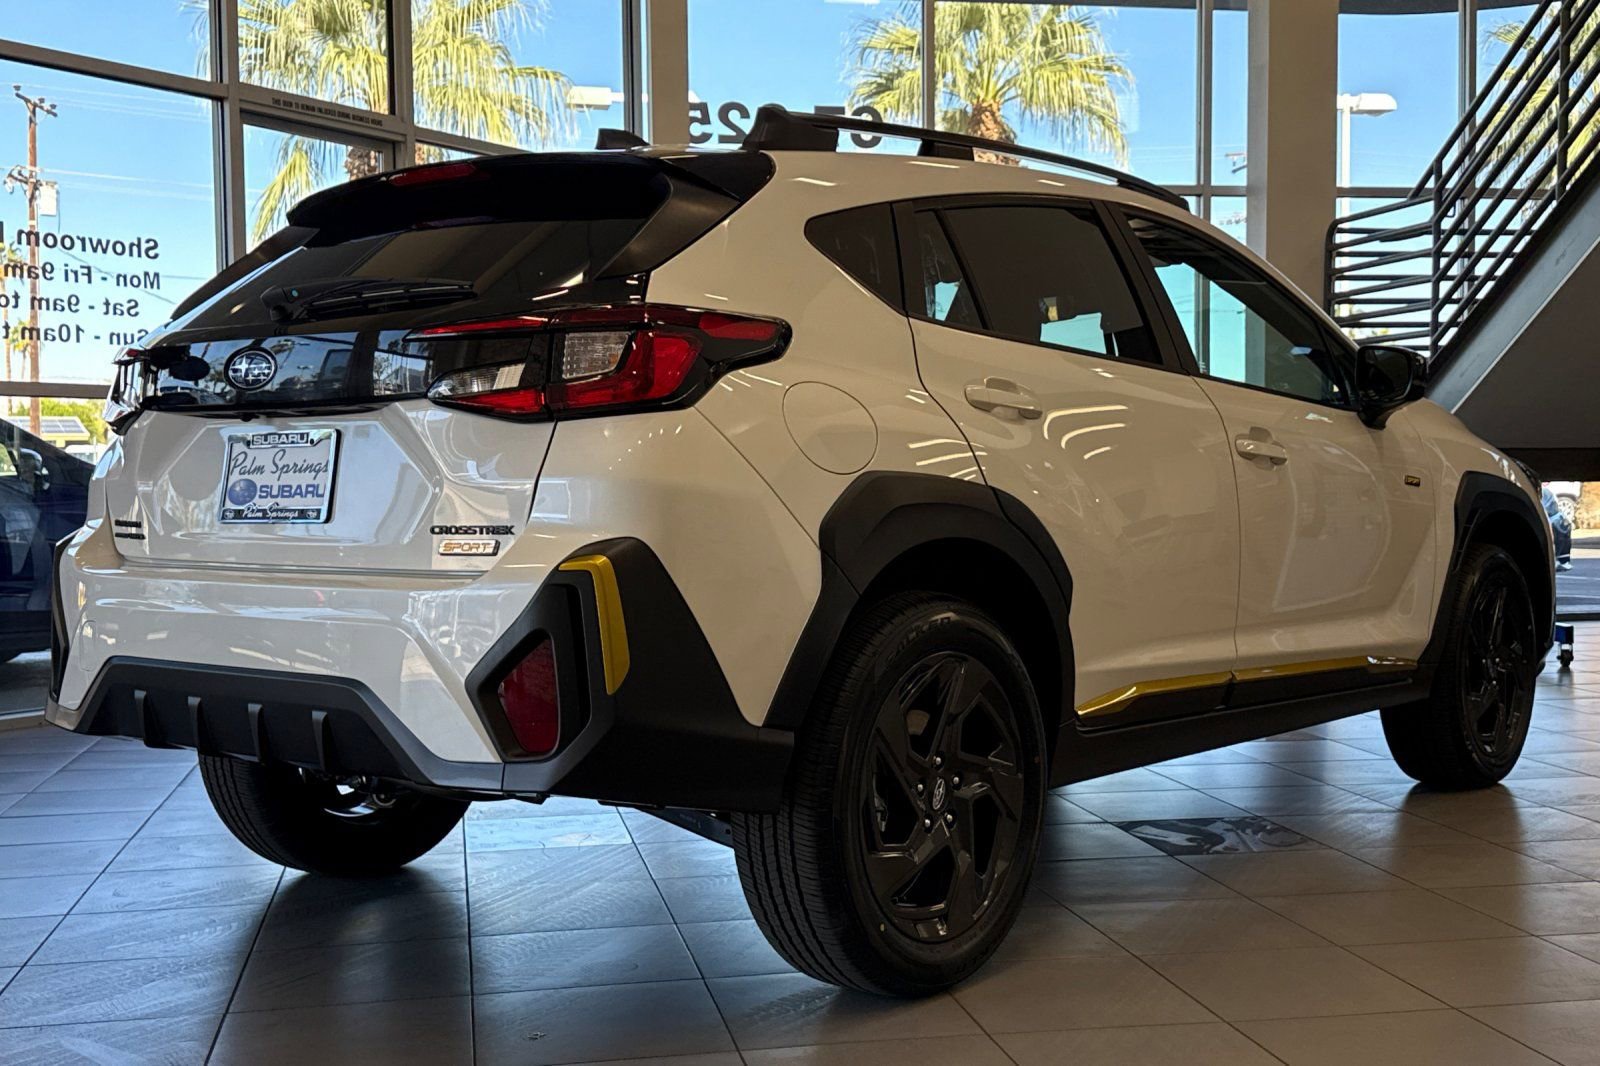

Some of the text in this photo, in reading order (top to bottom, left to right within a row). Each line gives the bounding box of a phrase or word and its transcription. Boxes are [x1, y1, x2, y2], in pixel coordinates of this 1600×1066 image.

[252, 433, 308, 446] SUBARU
[230, 449, 330, 481] Palm Springs
[258, 483, 327, 500] SUBARU
[242, 503, 299, 520] Palm Springs
[429, 525, 515, 535] CROSSTREK
[443, 542, 491, 553] SPORT
